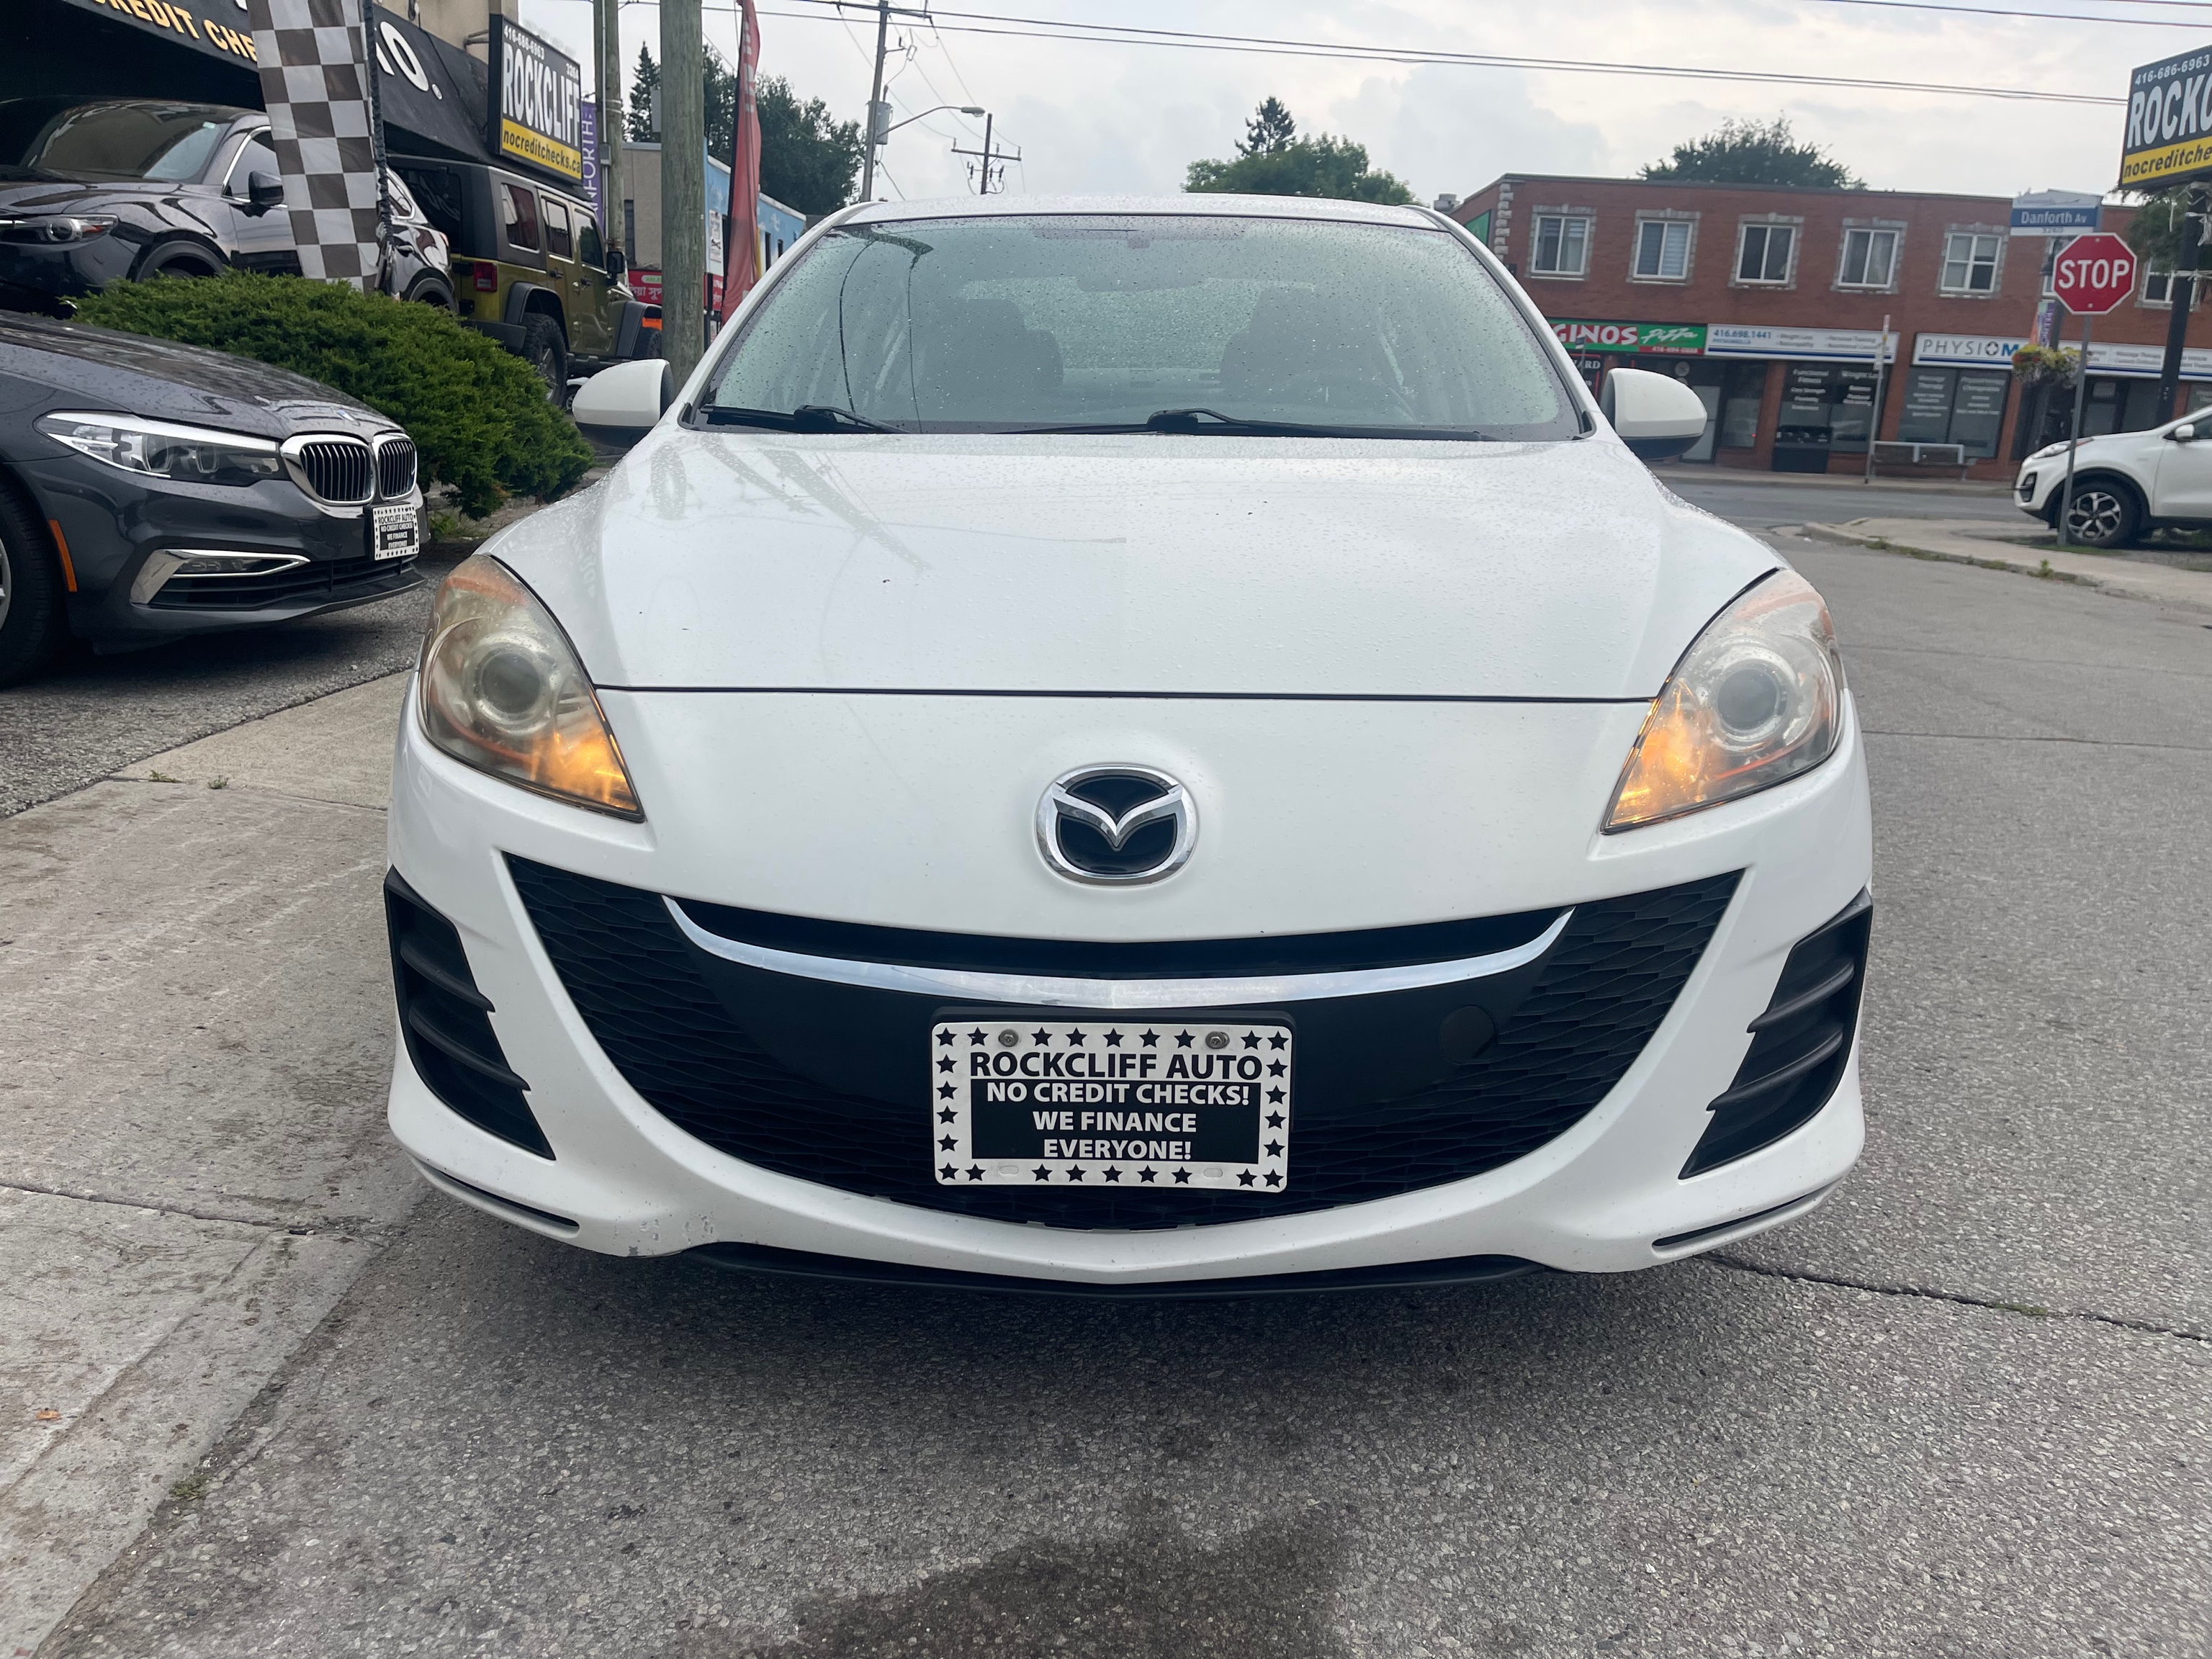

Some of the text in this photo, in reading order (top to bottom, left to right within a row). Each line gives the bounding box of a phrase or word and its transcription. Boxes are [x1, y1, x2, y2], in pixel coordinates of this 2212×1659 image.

[92, 0, 199, 39] EDIT
[2135, 54, 2211, 86] 416-686-6963
[503, 42, 580, 147] ROCKCLIFF
[503, 130, 581, 174] nocreditchecks.ca
[2020, 211, 2087, 224] Danforth Av
[2058, 258, 2131, 289] STOP
[1552, 323, 1639, 345] GINOS
[1714, 329, 1771, 339] 416.698.1441
[378, 514, 400, 524] ROCKCLIFF
[970, 1051, 1263, 1080] ROCKCLIFF AUTO
[986, 1082, 1250, 1106] NO CREDIT CHECKS!
[1032, 1111, 1197, 1133] WE FINANCE
[1043, 1138, 1192, 1160] EVERYONE!
